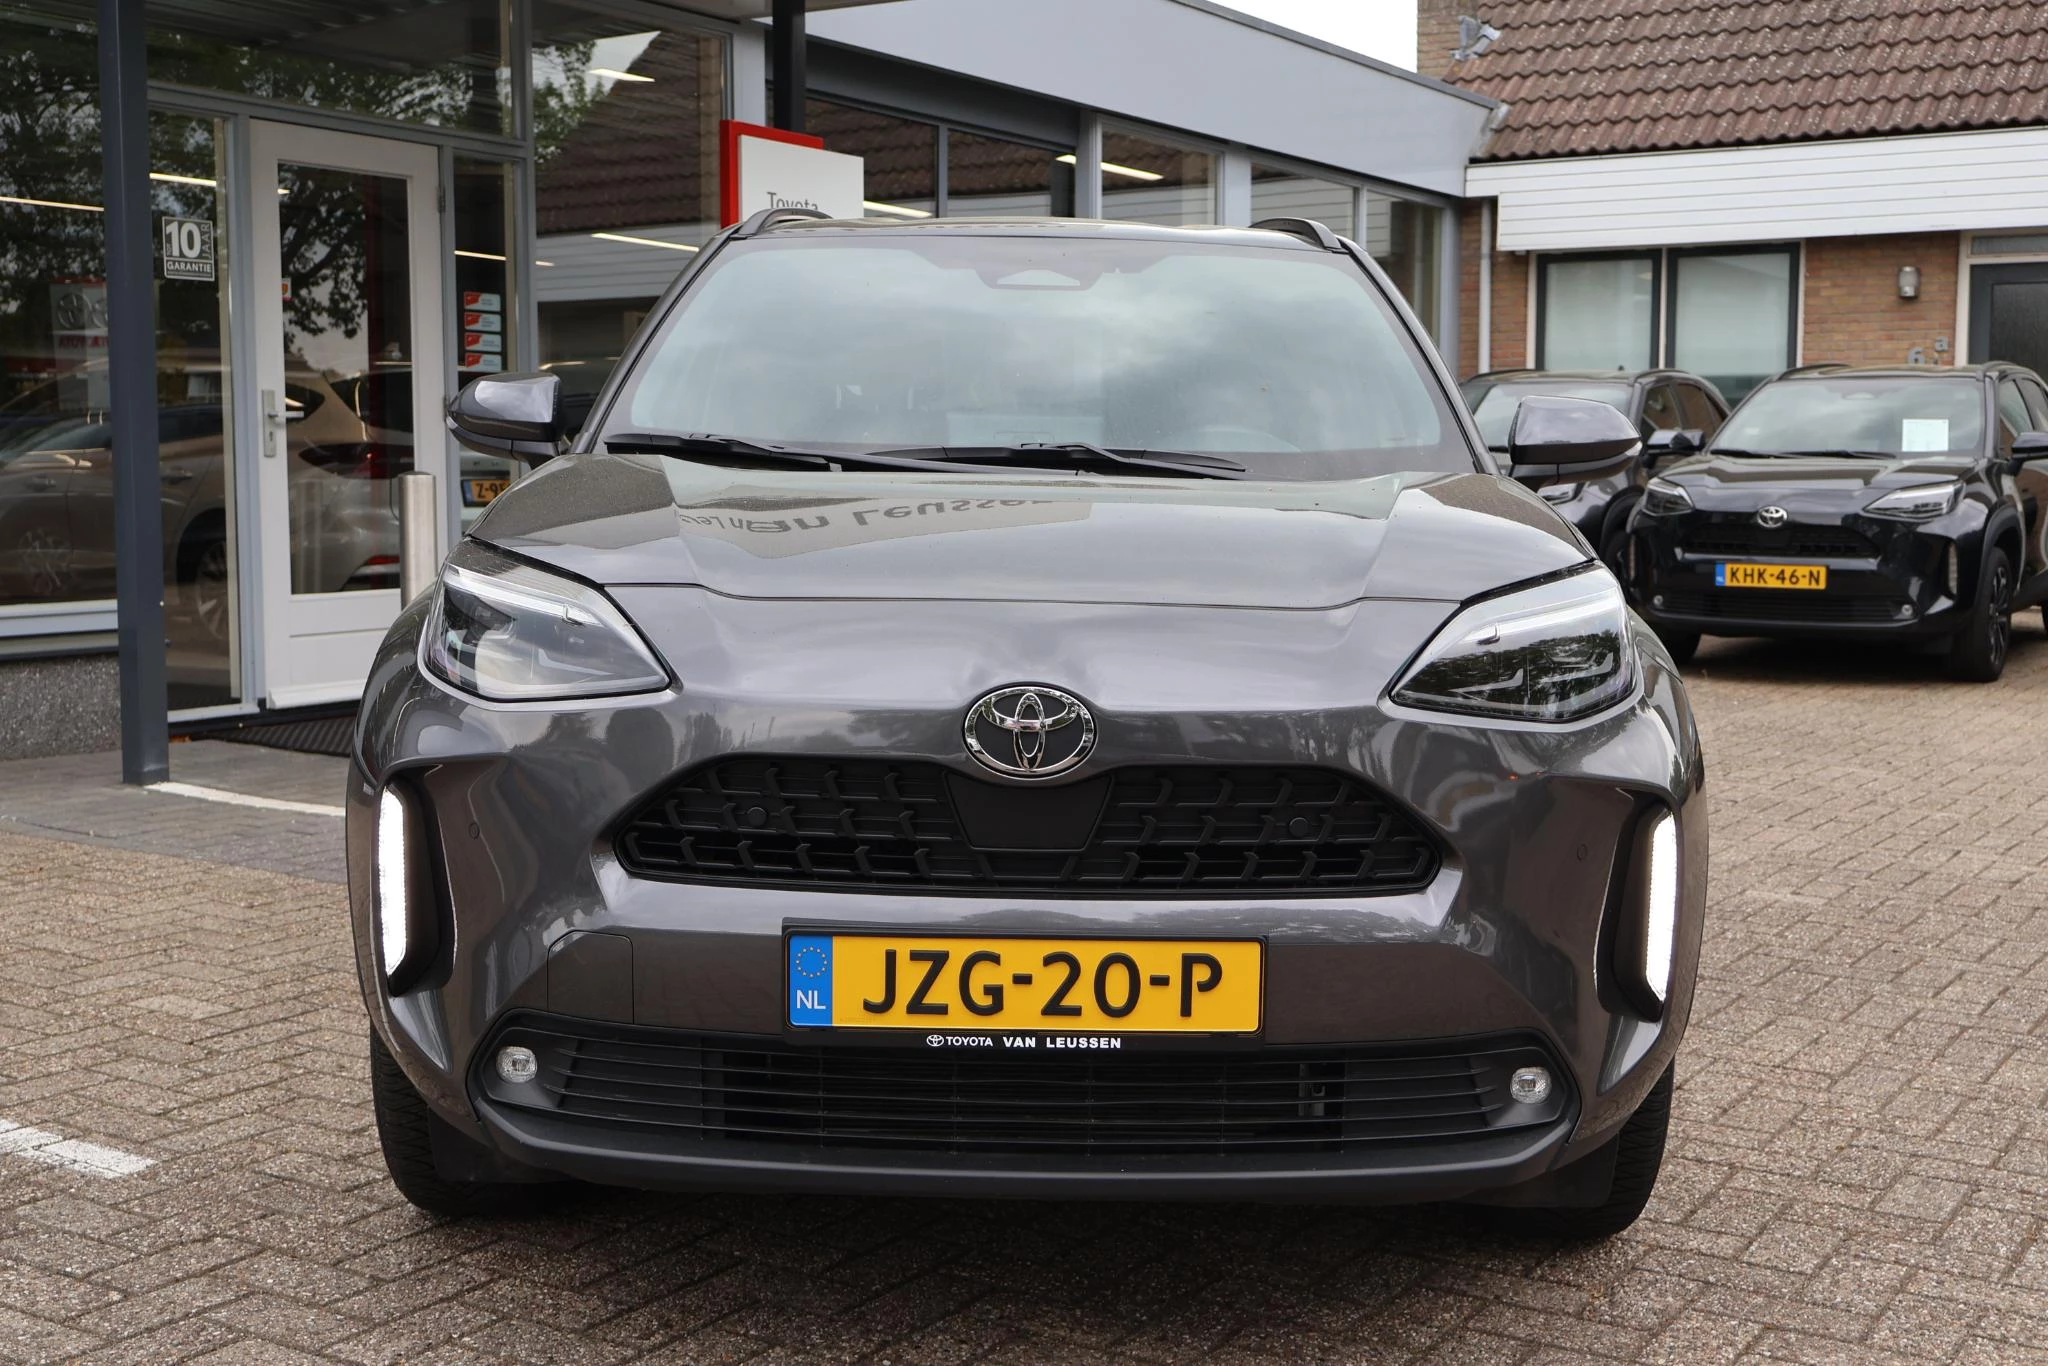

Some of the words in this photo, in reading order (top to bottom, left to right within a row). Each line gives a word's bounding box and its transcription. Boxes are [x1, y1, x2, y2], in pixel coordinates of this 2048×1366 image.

[166, 221, 201, 258] 10
[201, 223, 211, 260] JAAR
[167, 261, 212, 273] GARANTIE
[1730, 567, 1821, 586] KHK-46-N
[862, 948, 1224, 1018] JZG-20-P
[796, 989, 827, 1010] NL
[946, 1036, 994, 1047] TOYOTA
[1002, 1036, 1036, 1048] VAN
[1046, 1037, 1122, 1049] LEUSSEN
